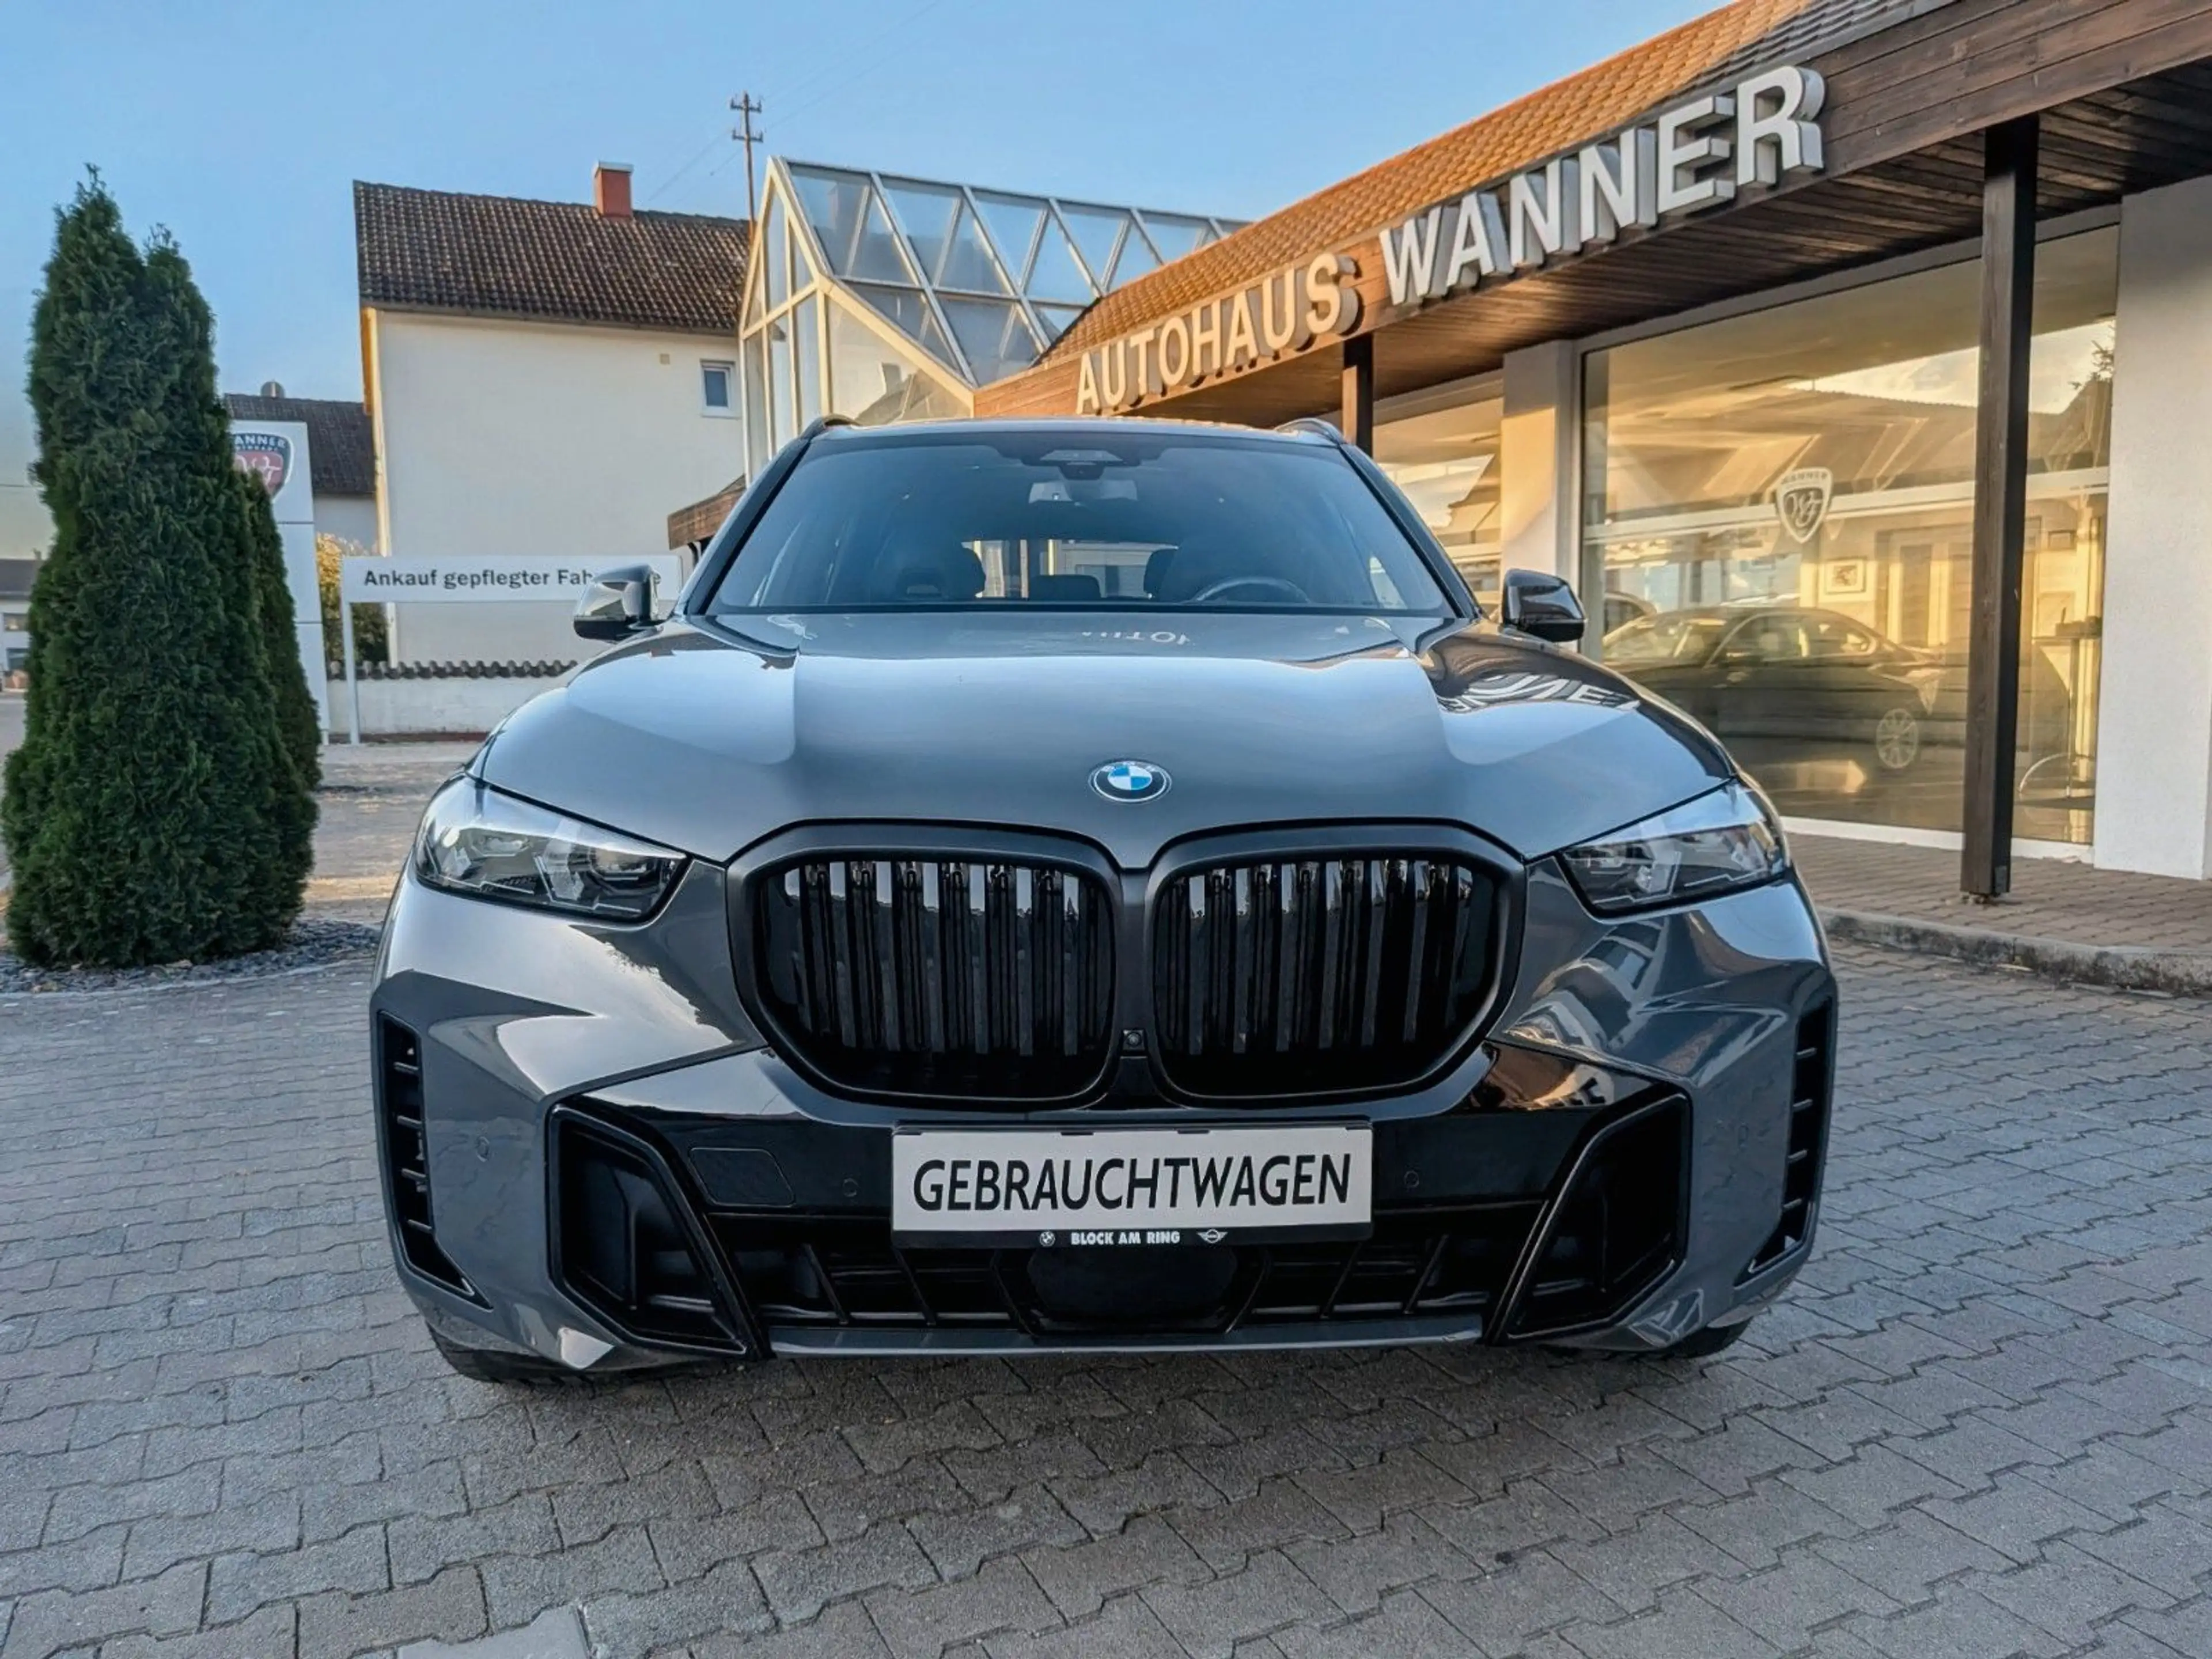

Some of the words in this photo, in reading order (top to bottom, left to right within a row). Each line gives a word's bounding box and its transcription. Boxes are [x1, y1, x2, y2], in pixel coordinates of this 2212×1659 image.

[1075, 252, 1358, 415] AUTOHAUS
[1379, 65, 1825, 305] WANNER
[234, 435, 286, 449] ANNER
[365, 569, 437, 586] Ankauf
[444, 569, 550, 589] gepflegter
[914, 1154, 1351, 1211] GEBRAUCHTWAGEN
[1071, 1232, 1114, 1245] BLOCK
[1118, 1232, 1141, 1244] AM
[1147, 1231, 1180, 1244] RING
